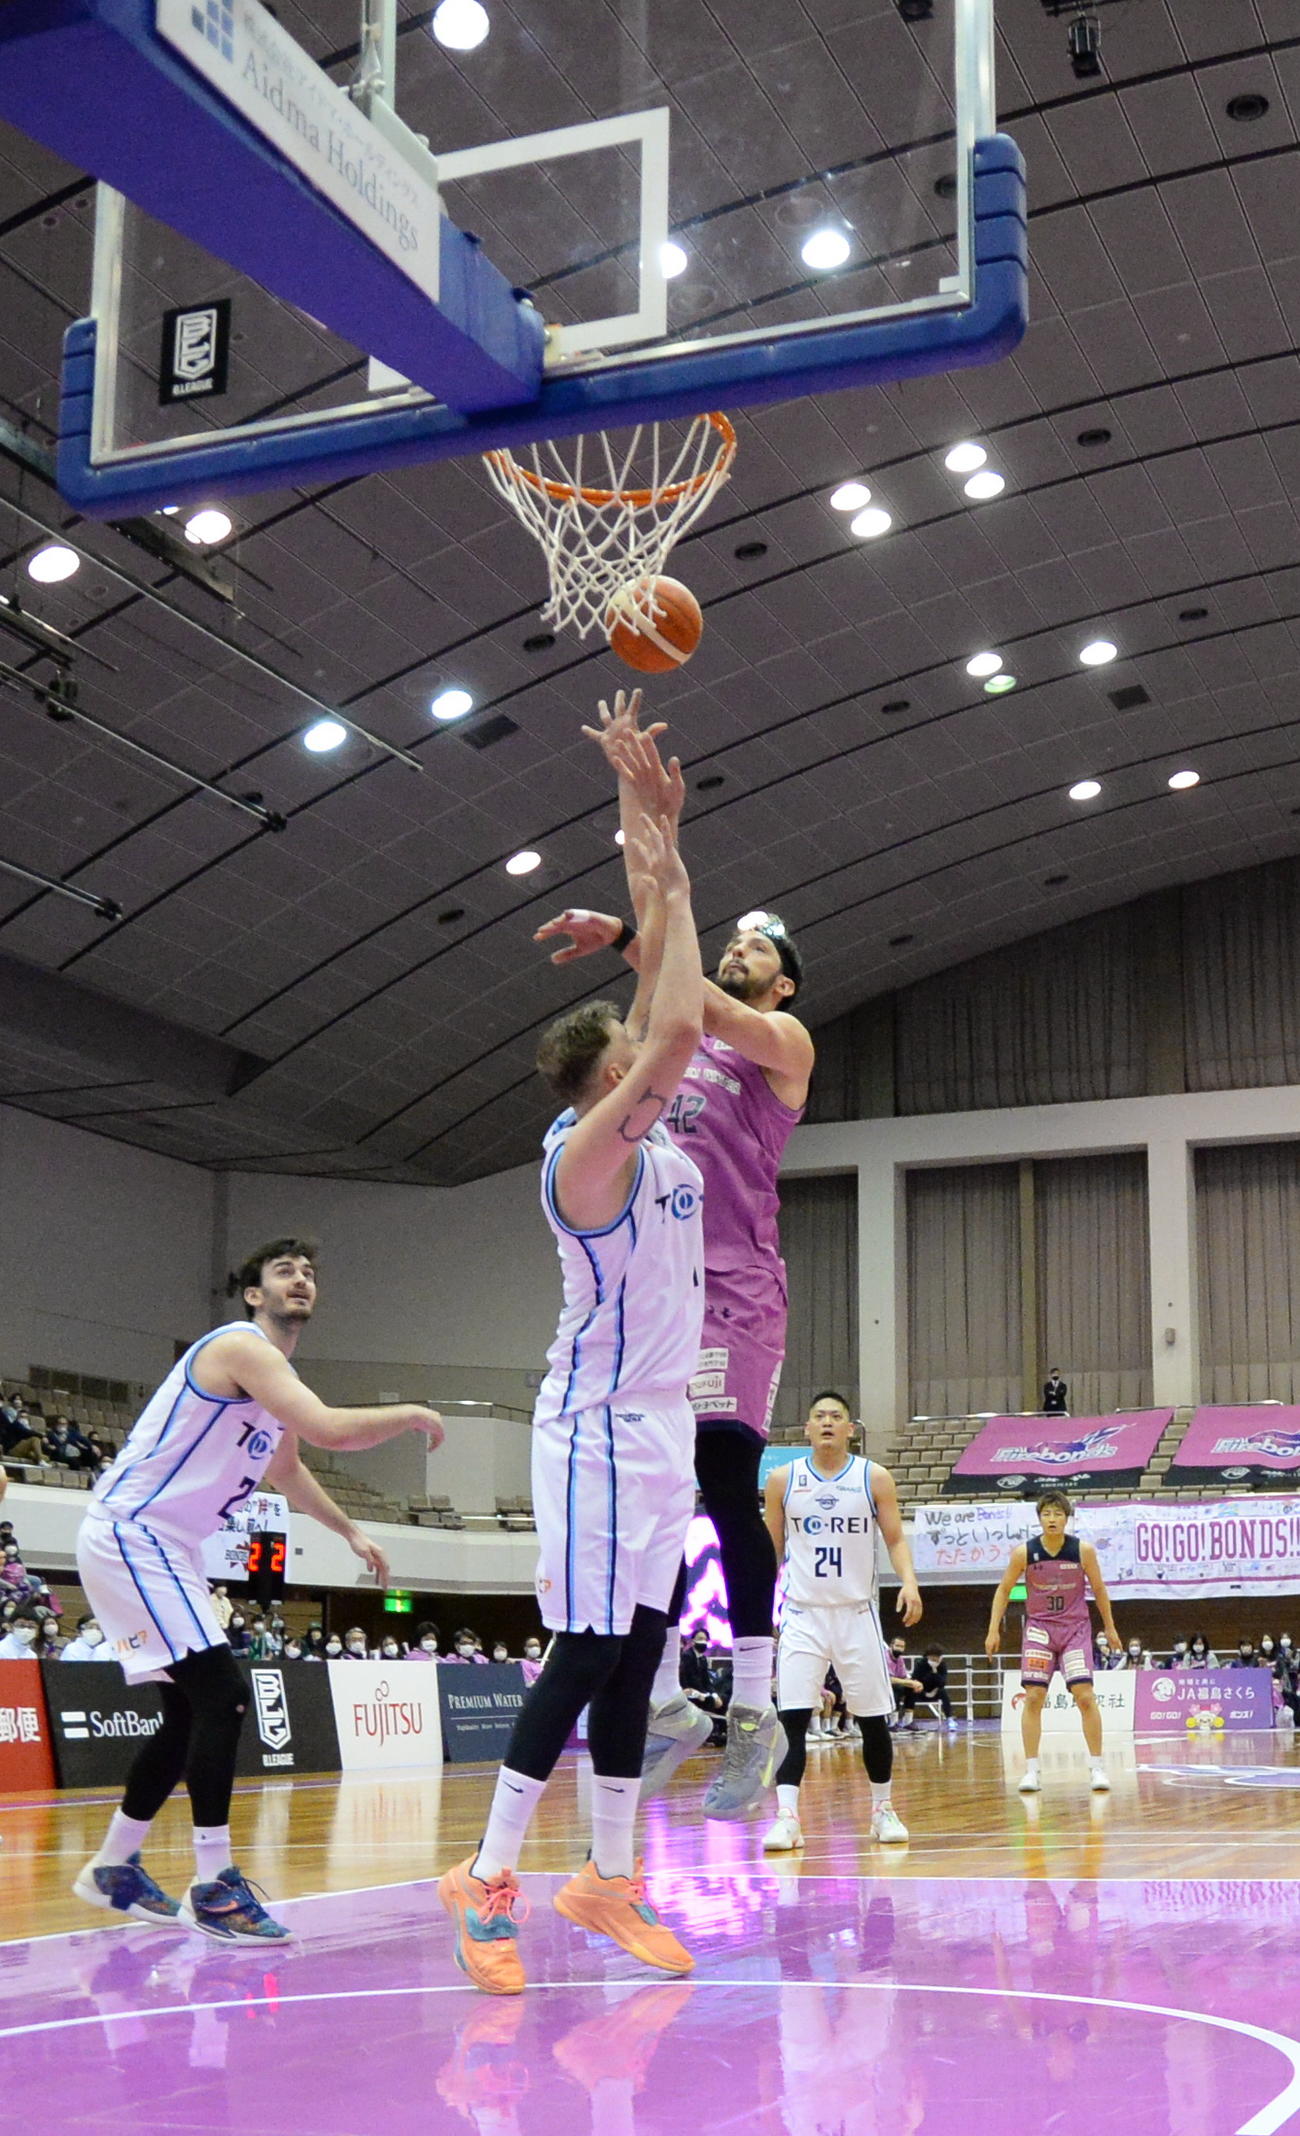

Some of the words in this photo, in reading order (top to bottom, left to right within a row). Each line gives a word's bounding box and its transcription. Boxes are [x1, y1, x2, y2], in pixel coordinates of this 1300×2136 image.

[241, 49, 320, 153] Aidma
[327, 129, 418, 252] Holdings
[667, 1094, 706, 1134] 42
[217, 1475, 257, 1519] 2
[925, 1510, 951, 1527] We
[954, 1510, 975, 1525] are
[814, 1546, 842, 1578] 24
[1046, 1595, 1065, 1612] 30
[353, 1702, 423, 1747] FUJITSU
